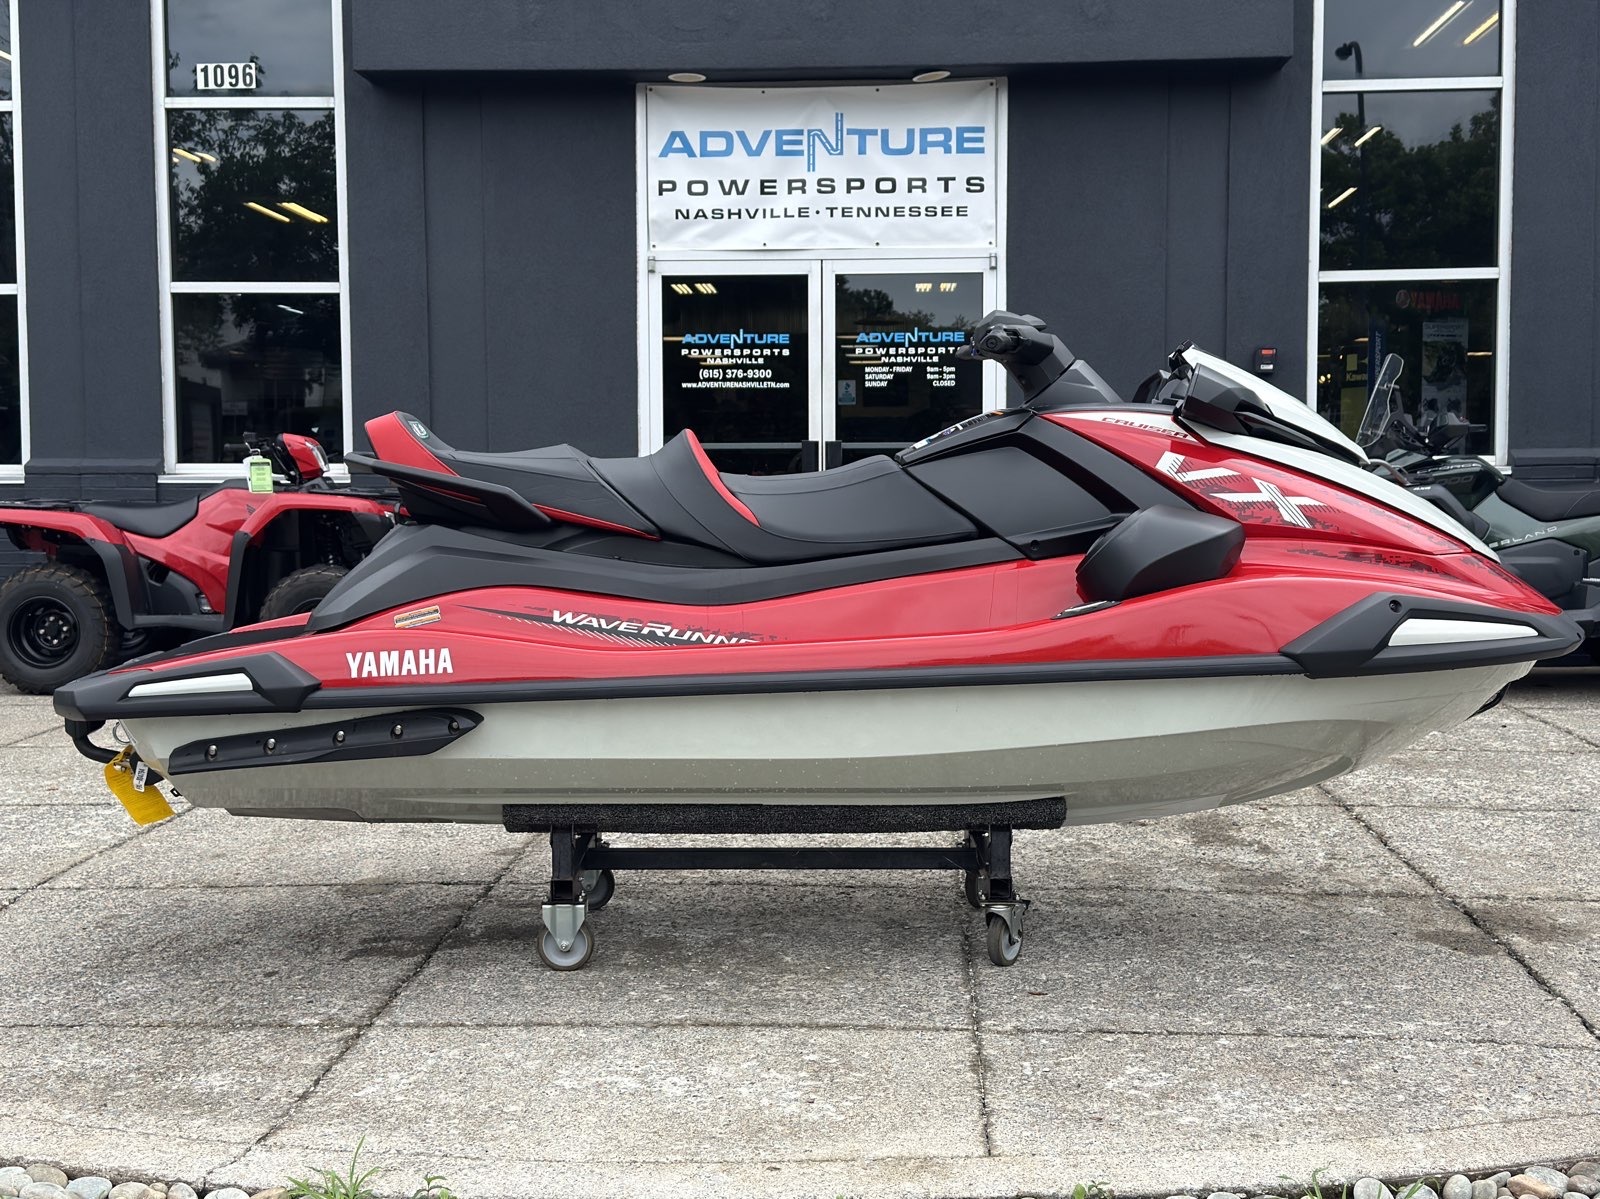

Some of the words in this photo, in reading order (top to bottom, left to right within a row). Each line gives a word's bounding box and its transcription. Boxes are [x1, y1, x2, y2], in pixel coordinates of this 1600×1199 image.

[200, 64, 254, 88] 1096
[658, 112, 985, 172] ADVENTURE
[657, 176, 986, 197] POWERSPORTS
[675, 207, 810, 220] NASHVILLE
[826, 205, 968, 218] TENNESSEE
[682, 329, 790, 349] ADVENTURE
[856, 327, 965, 347] ADVENTURE
[681, 348, 790, 356] POWERSPORTS
[855, 347, 961, 355] POWERSPORT
[699, 369, 723, 380] (615)
[725, 369, 772, 379] 376-9300
[1101, 416, 1189, 439] CRUISER
[1155, 451, 1328, 528] VX
[345, 647, 454, 679] YAMAHA
